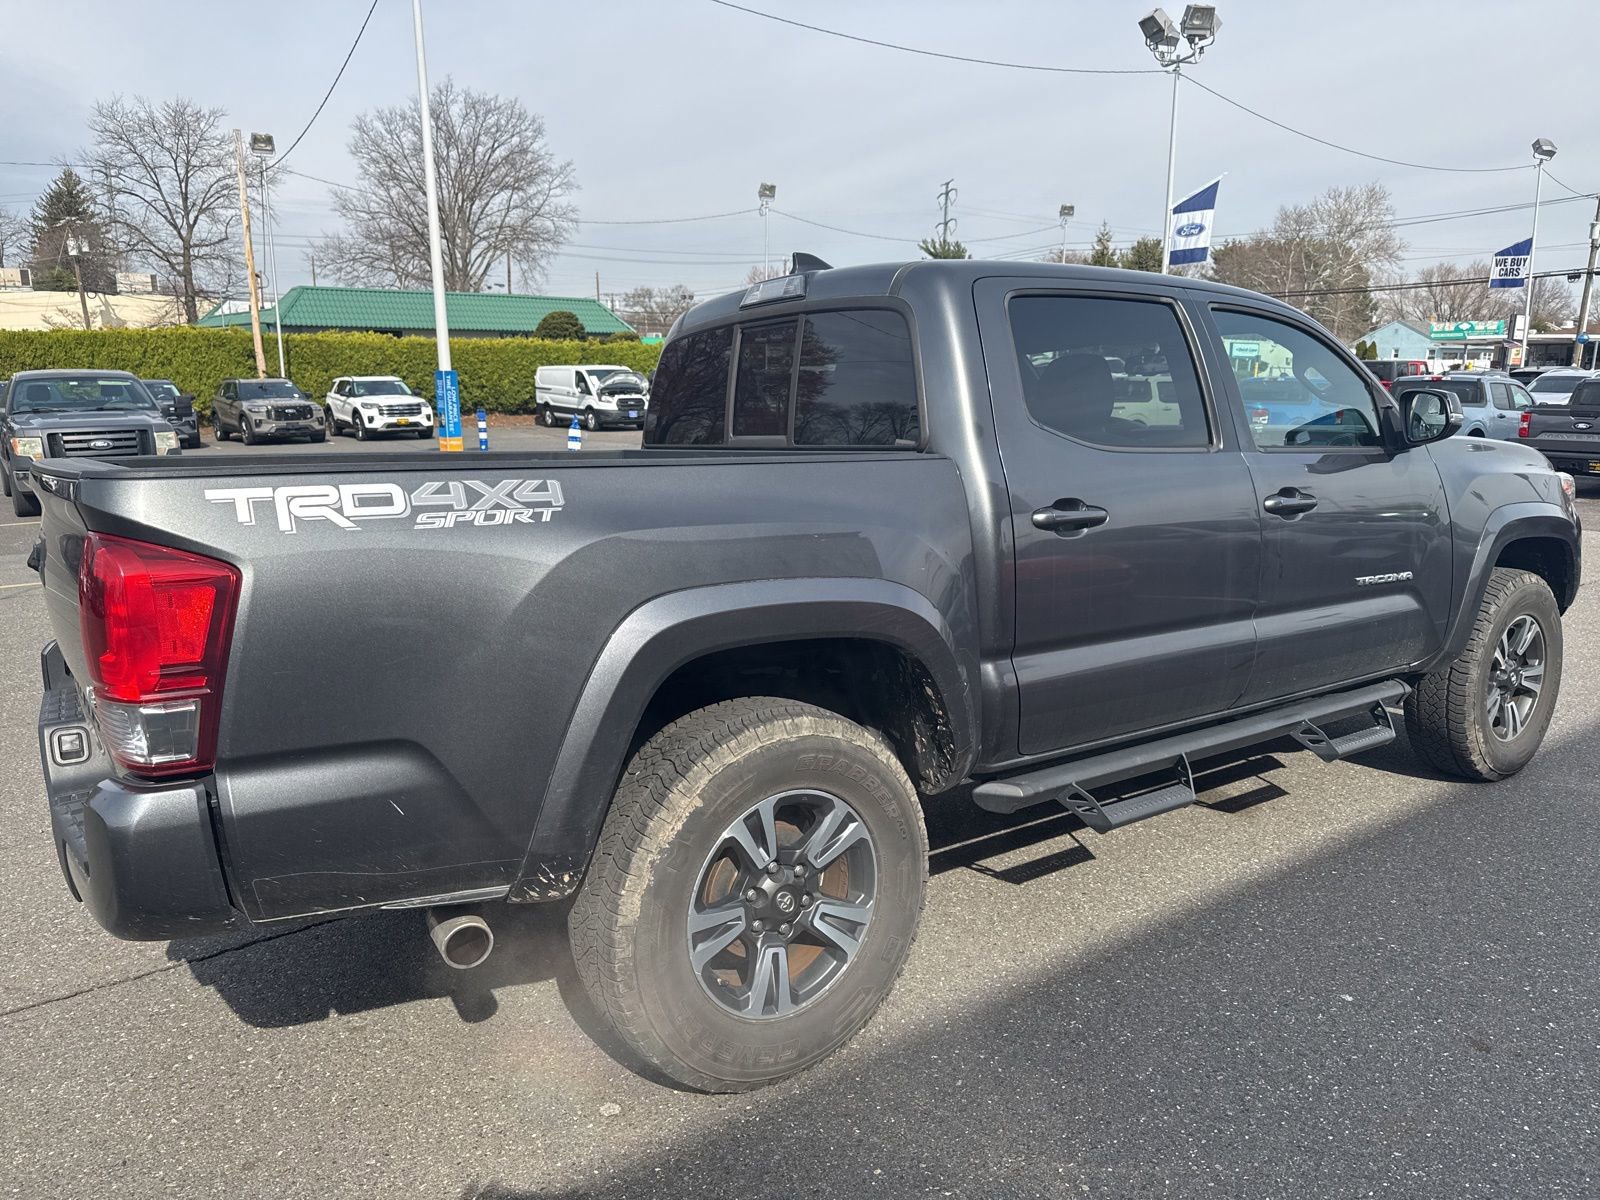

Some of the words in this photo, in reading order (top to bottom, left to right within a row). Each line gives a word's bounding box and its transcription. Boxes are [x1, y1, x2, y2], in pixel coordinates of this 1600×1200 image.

[1180, 224, 1201, 237] Ford
[1495, 257, 1508, 267] WE
[1510, 257, 1528, 267] BUY
[1498, 267, 1521, 277] CARS
[204, 482, 412, 535] TRD
[410, 479, 565, 510] 4X4
[414, 506, 562, 530] SPORT
[1354, 571, 1414, 585] TACOMA
[795, 753, 898, 822] GRABBER
